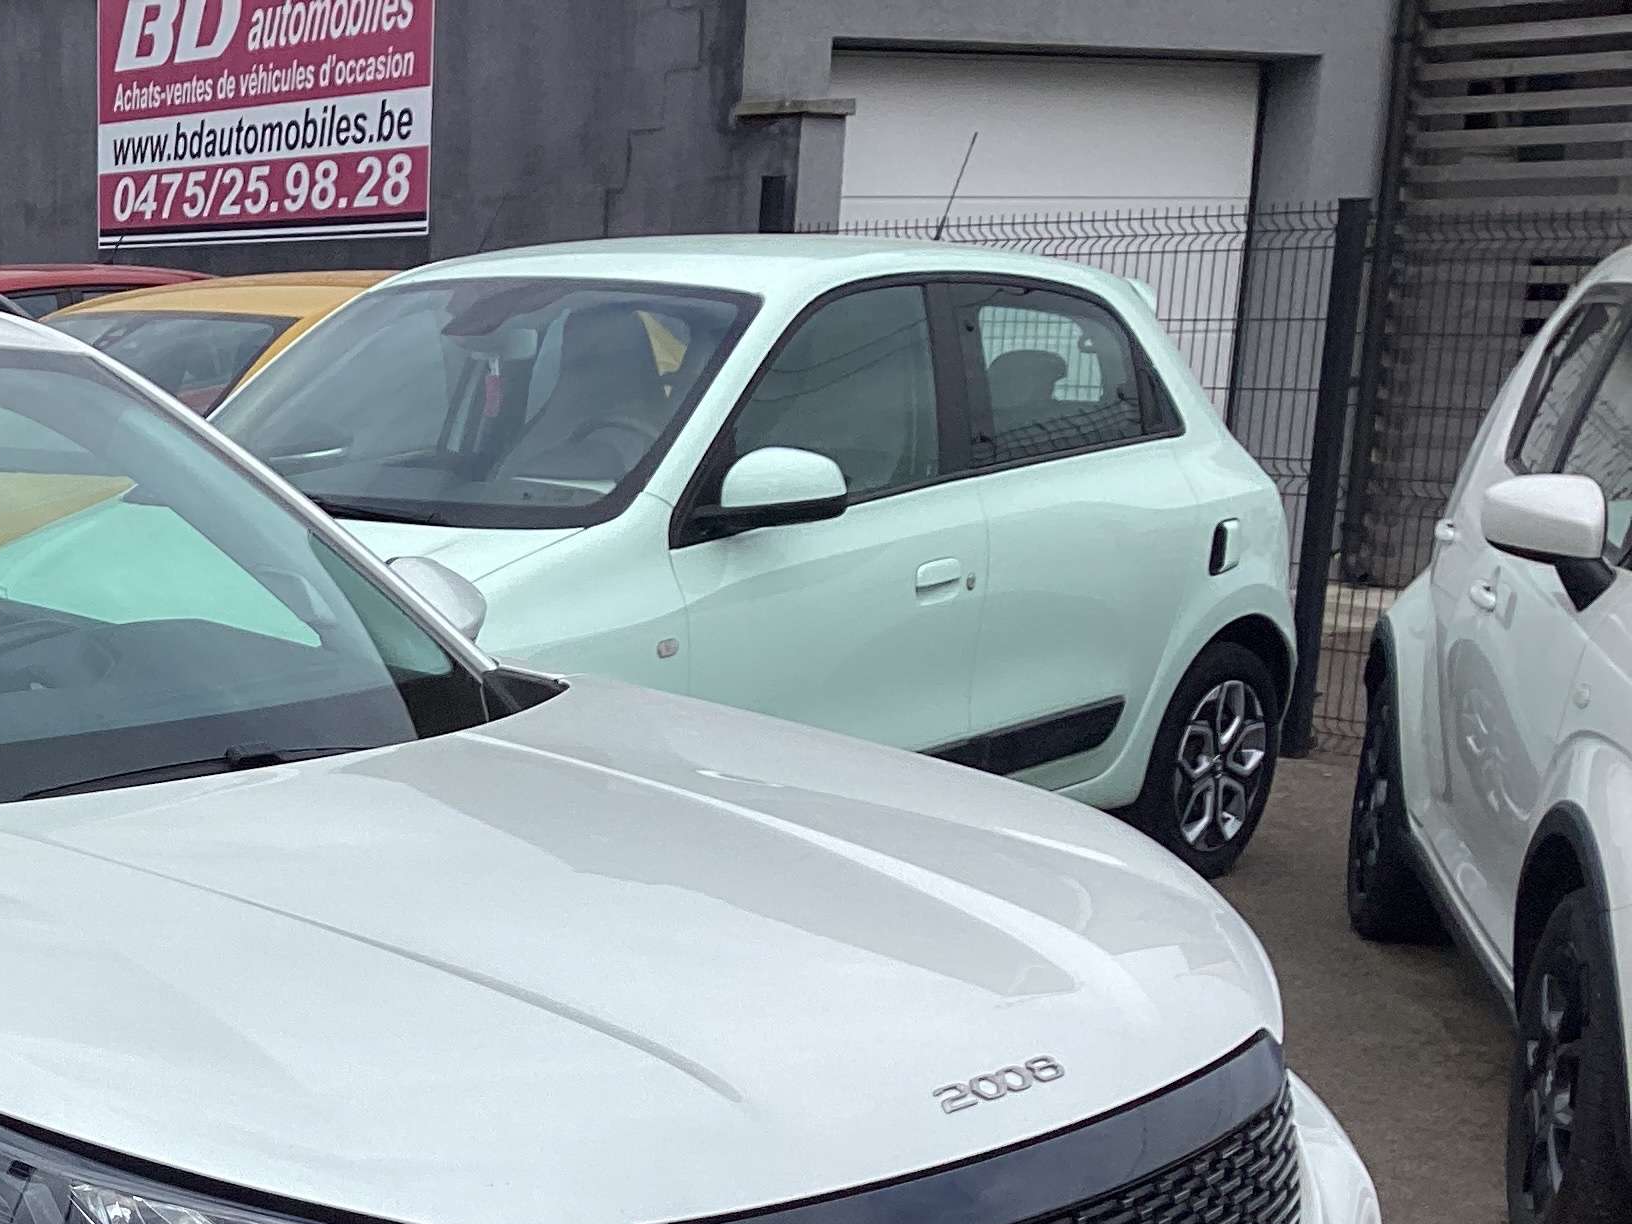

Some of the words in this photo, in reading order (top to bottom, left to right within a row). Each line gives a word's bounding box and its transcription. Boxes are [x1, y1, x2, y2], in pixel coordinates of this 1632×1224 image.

[114, 0, 241, 72] BD
[248, 0, 414, 51] automobiles
[113, 75, 213, 112] Achats-ventes
[217, 71, 235, 99] de
[240, 61, 314, 97] véhicules
[319, 46, 415, 87] d'occasion
[113, 100, 413, 167] www.bdautomobiles.be
[112, 153, 413, 222] 0475/25.98.28
[933, 1055, 1065, 1114] 2008
